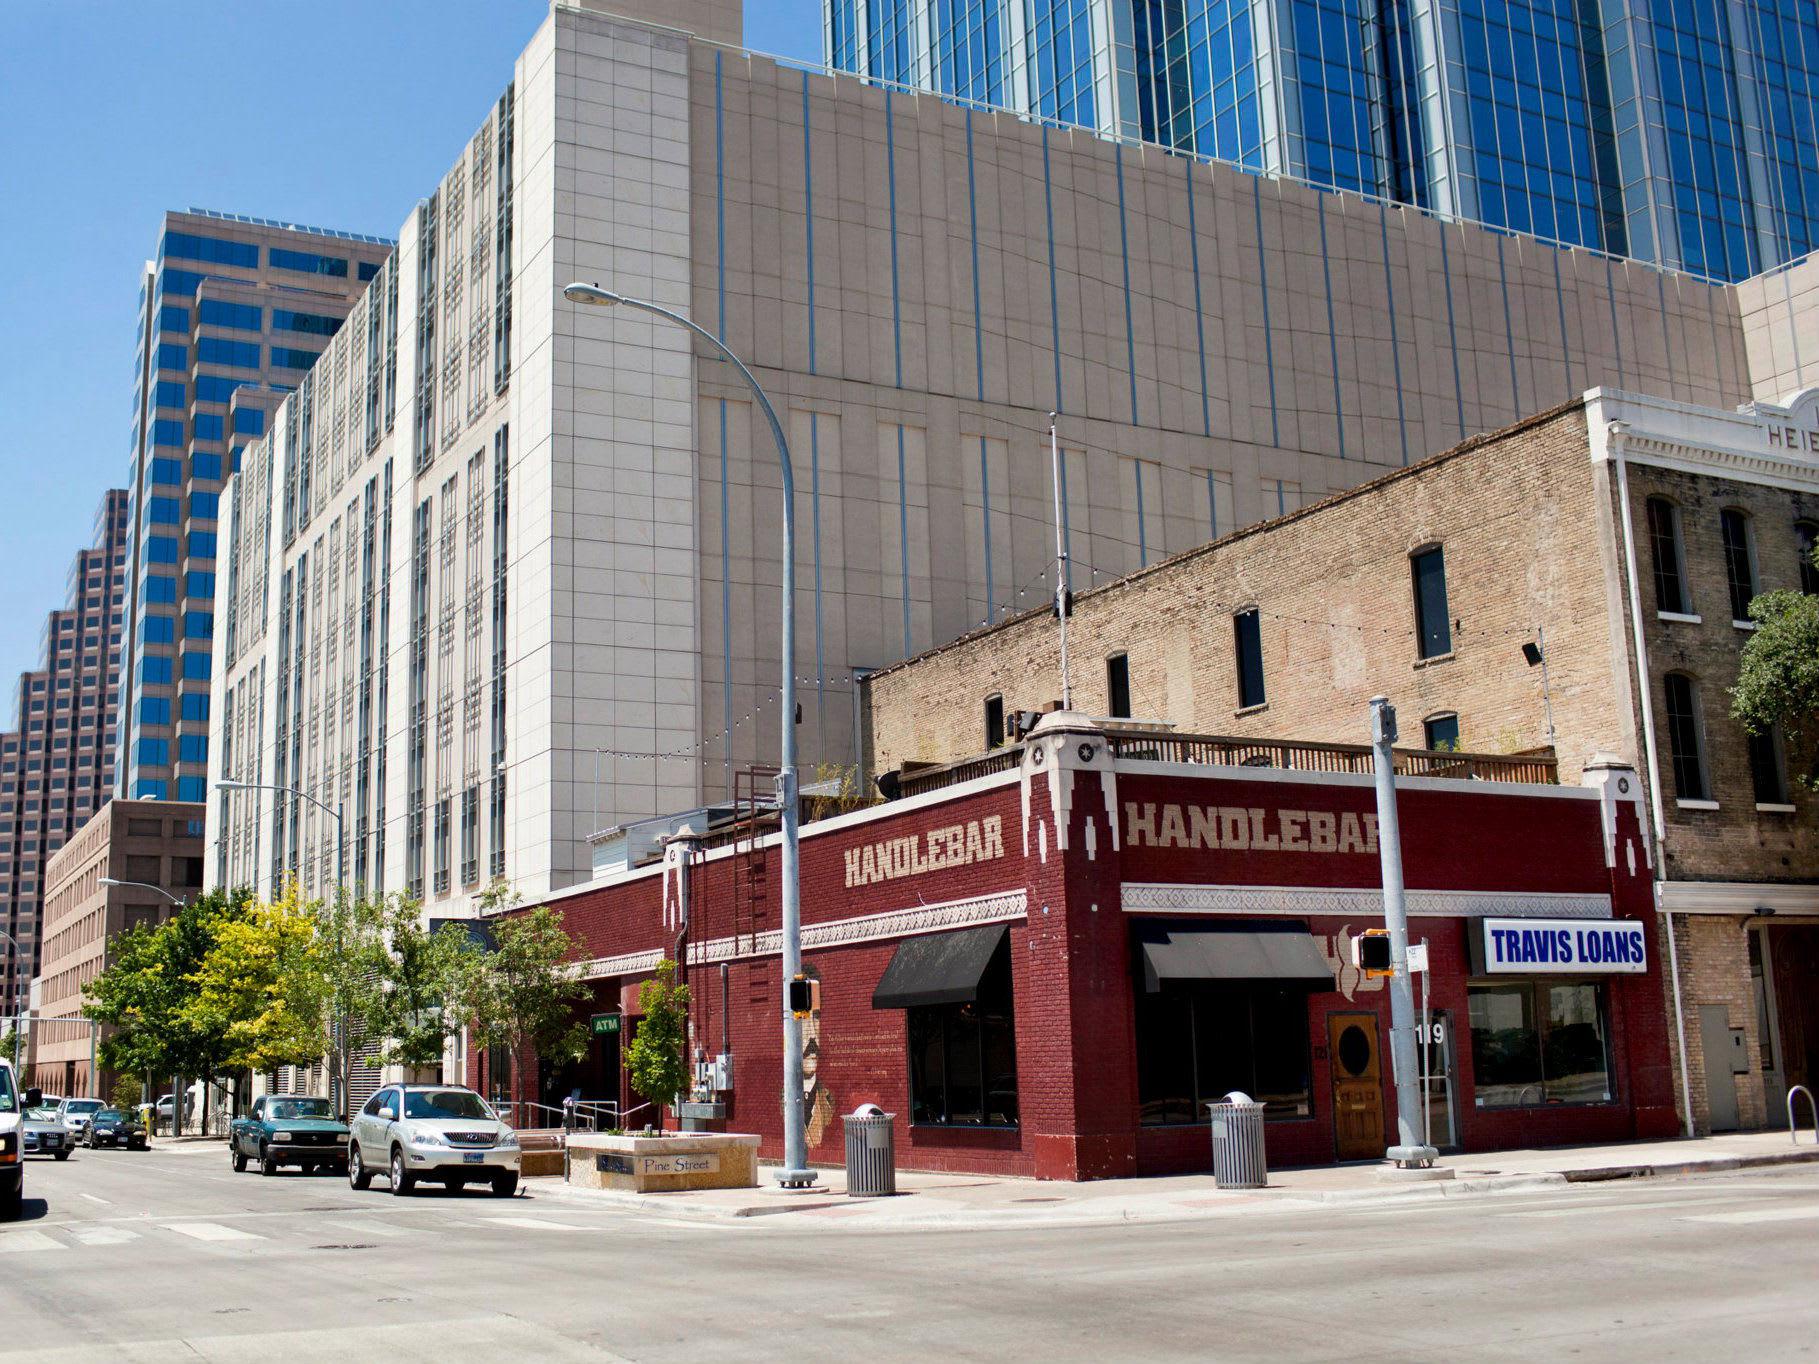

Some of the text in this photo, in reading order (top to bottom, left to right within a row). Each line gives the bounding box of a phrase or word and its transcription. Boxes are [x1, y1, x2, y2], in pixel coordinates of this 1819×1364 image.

[844, 815, 1005, 888] HANDLEBAR
[1491, 929, 1644, 963] TRAVIS LOANS
[595, 1018, 618, 1031] ATM
[644, 1159, 670, 1173] Pine
[674, 1157, 710, 1172] Street
